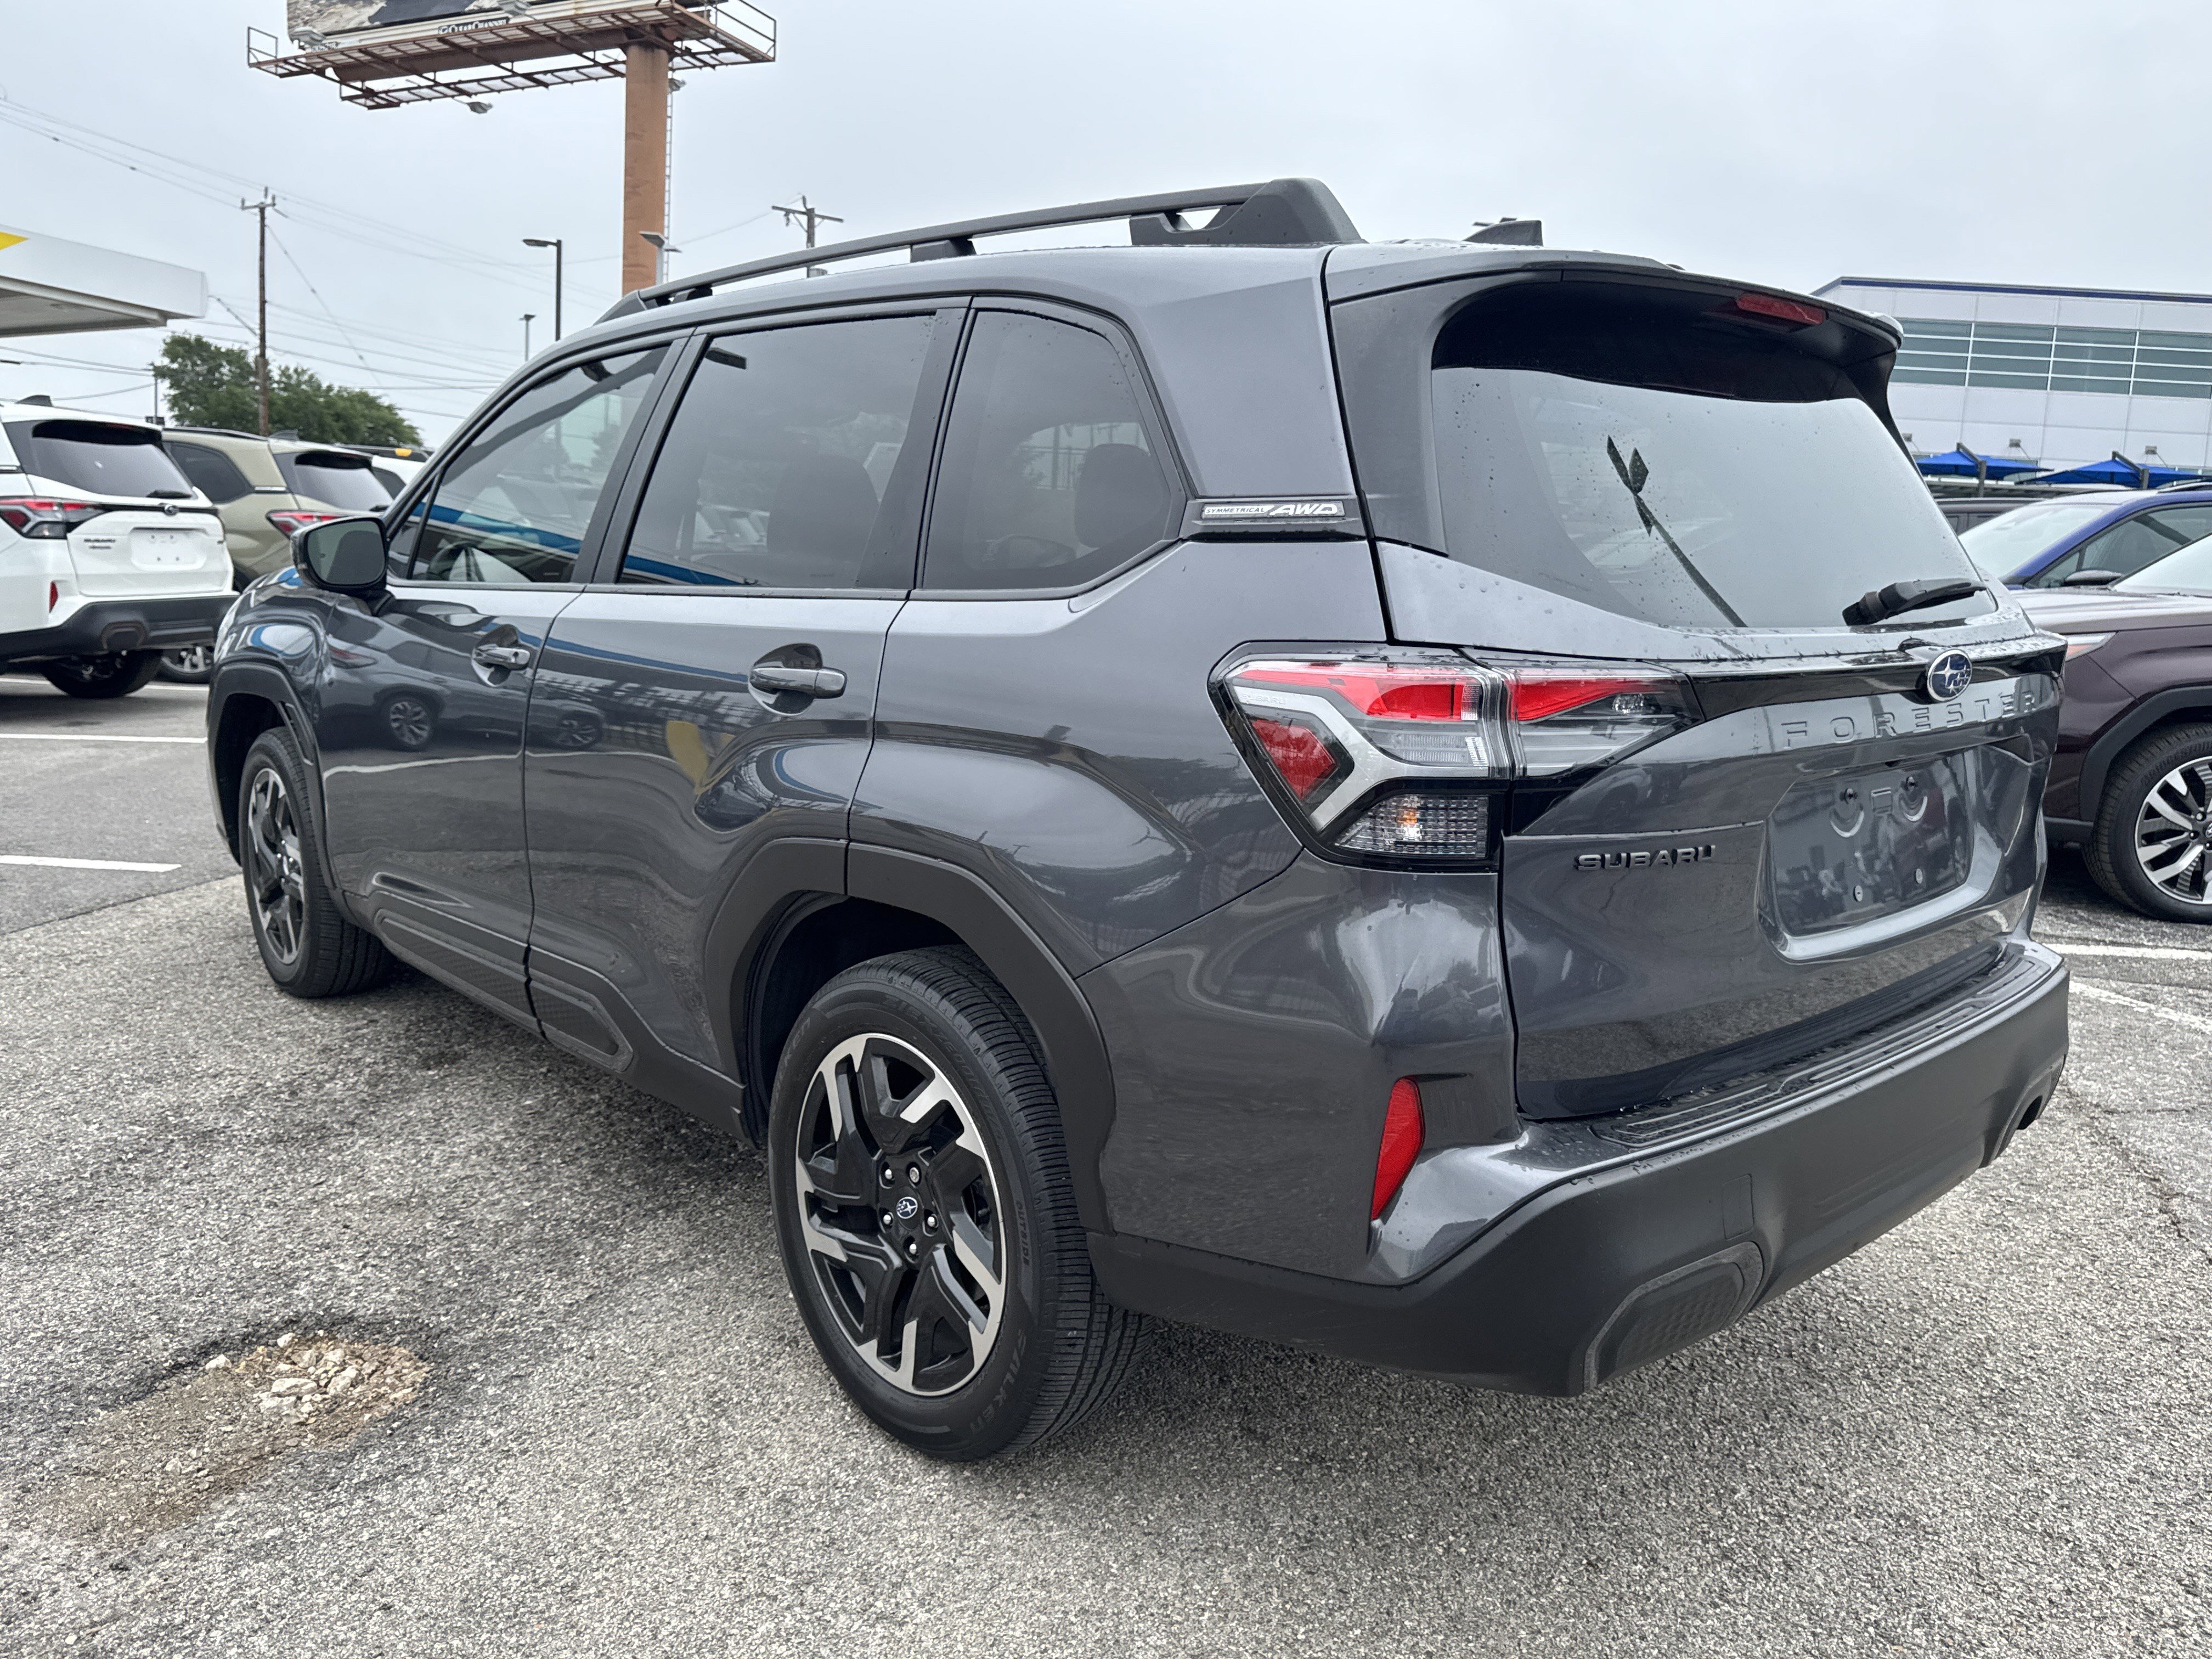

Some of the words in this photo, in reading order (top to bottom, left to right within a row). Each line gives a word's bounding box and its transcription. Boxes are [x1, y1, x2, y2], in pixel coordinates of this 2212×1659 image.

[1269, 504, 1339, 516] AWD
[1780, 690, 2036, 750] FORESTER
[1573, 844, 1716, 871] SUBARU
[970, 1328, 1028, 1434] FALKEN
